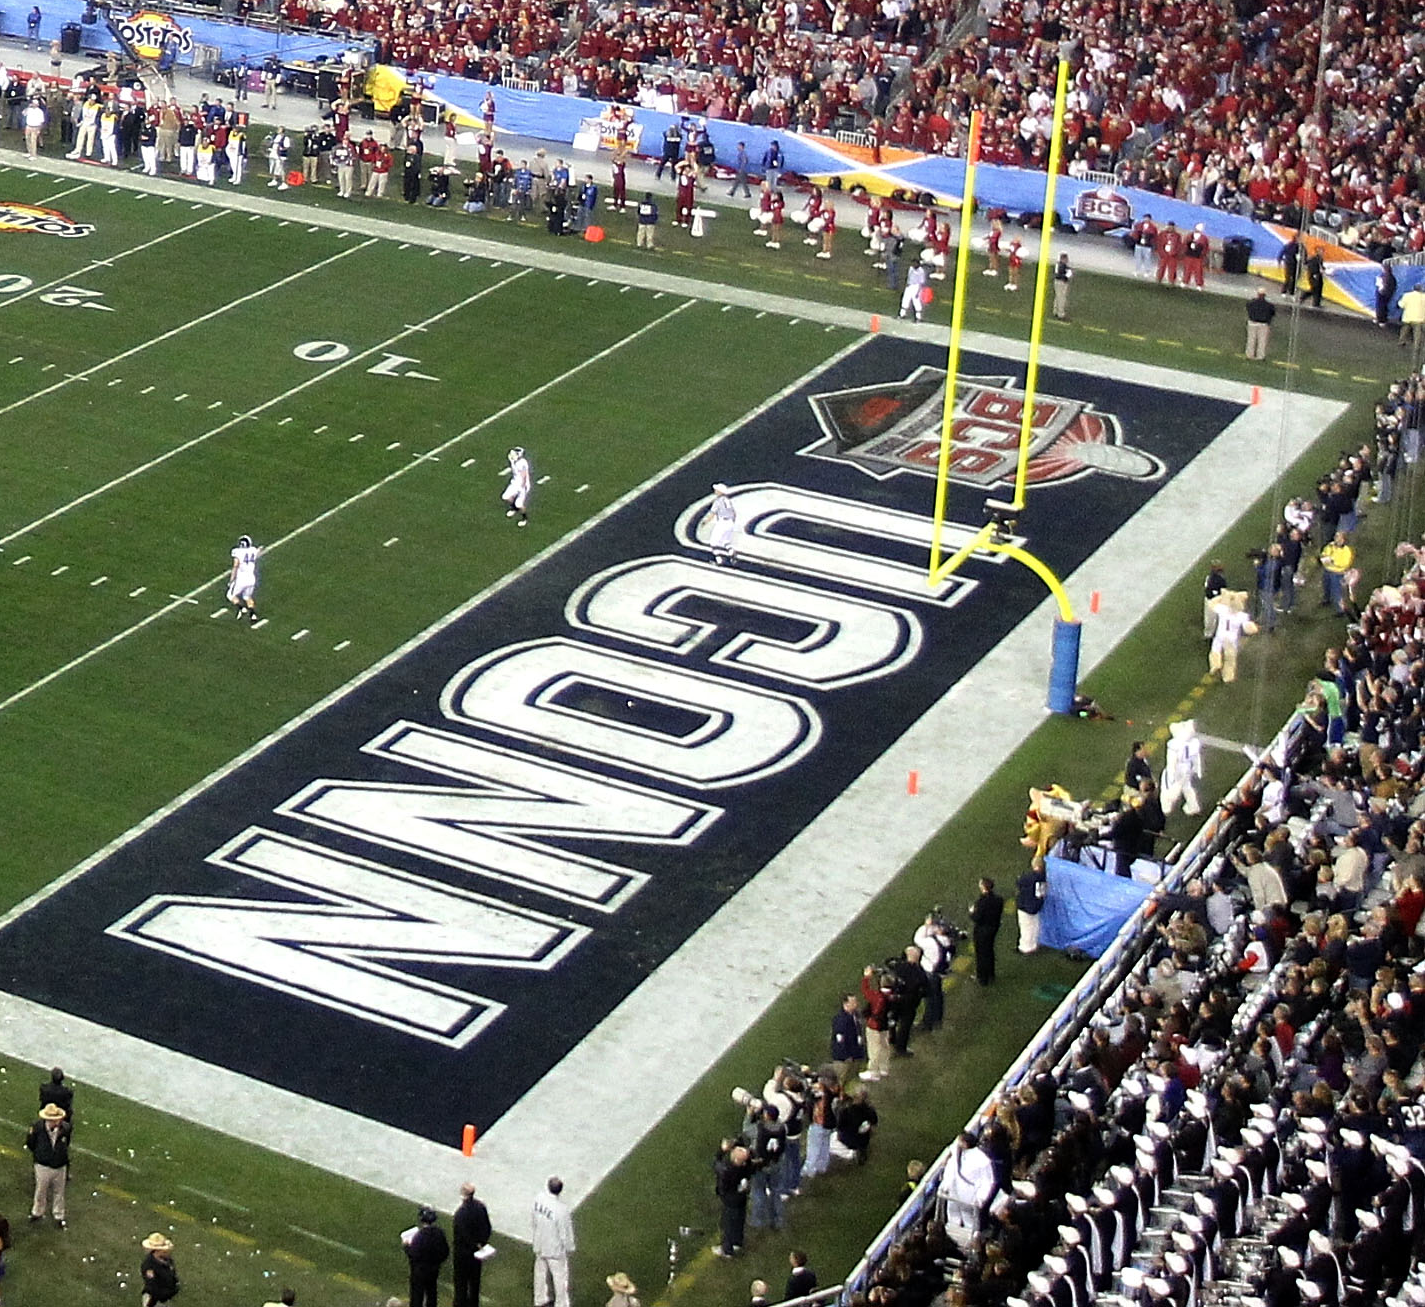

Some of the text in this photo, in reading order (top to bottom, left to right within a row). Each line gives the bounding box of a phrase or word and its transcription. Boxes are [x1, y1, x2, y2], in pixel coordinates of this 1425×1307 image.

[1080, 198, 1128, 219] BCS
[293, 340, 423, 378] 10
[899, 388, 1057, 478] BCS
[243, 552, 256, 565] 44
[103, 482, 1030, 1050] UCONN
[1401, 1105, 1425, 1127] 32
